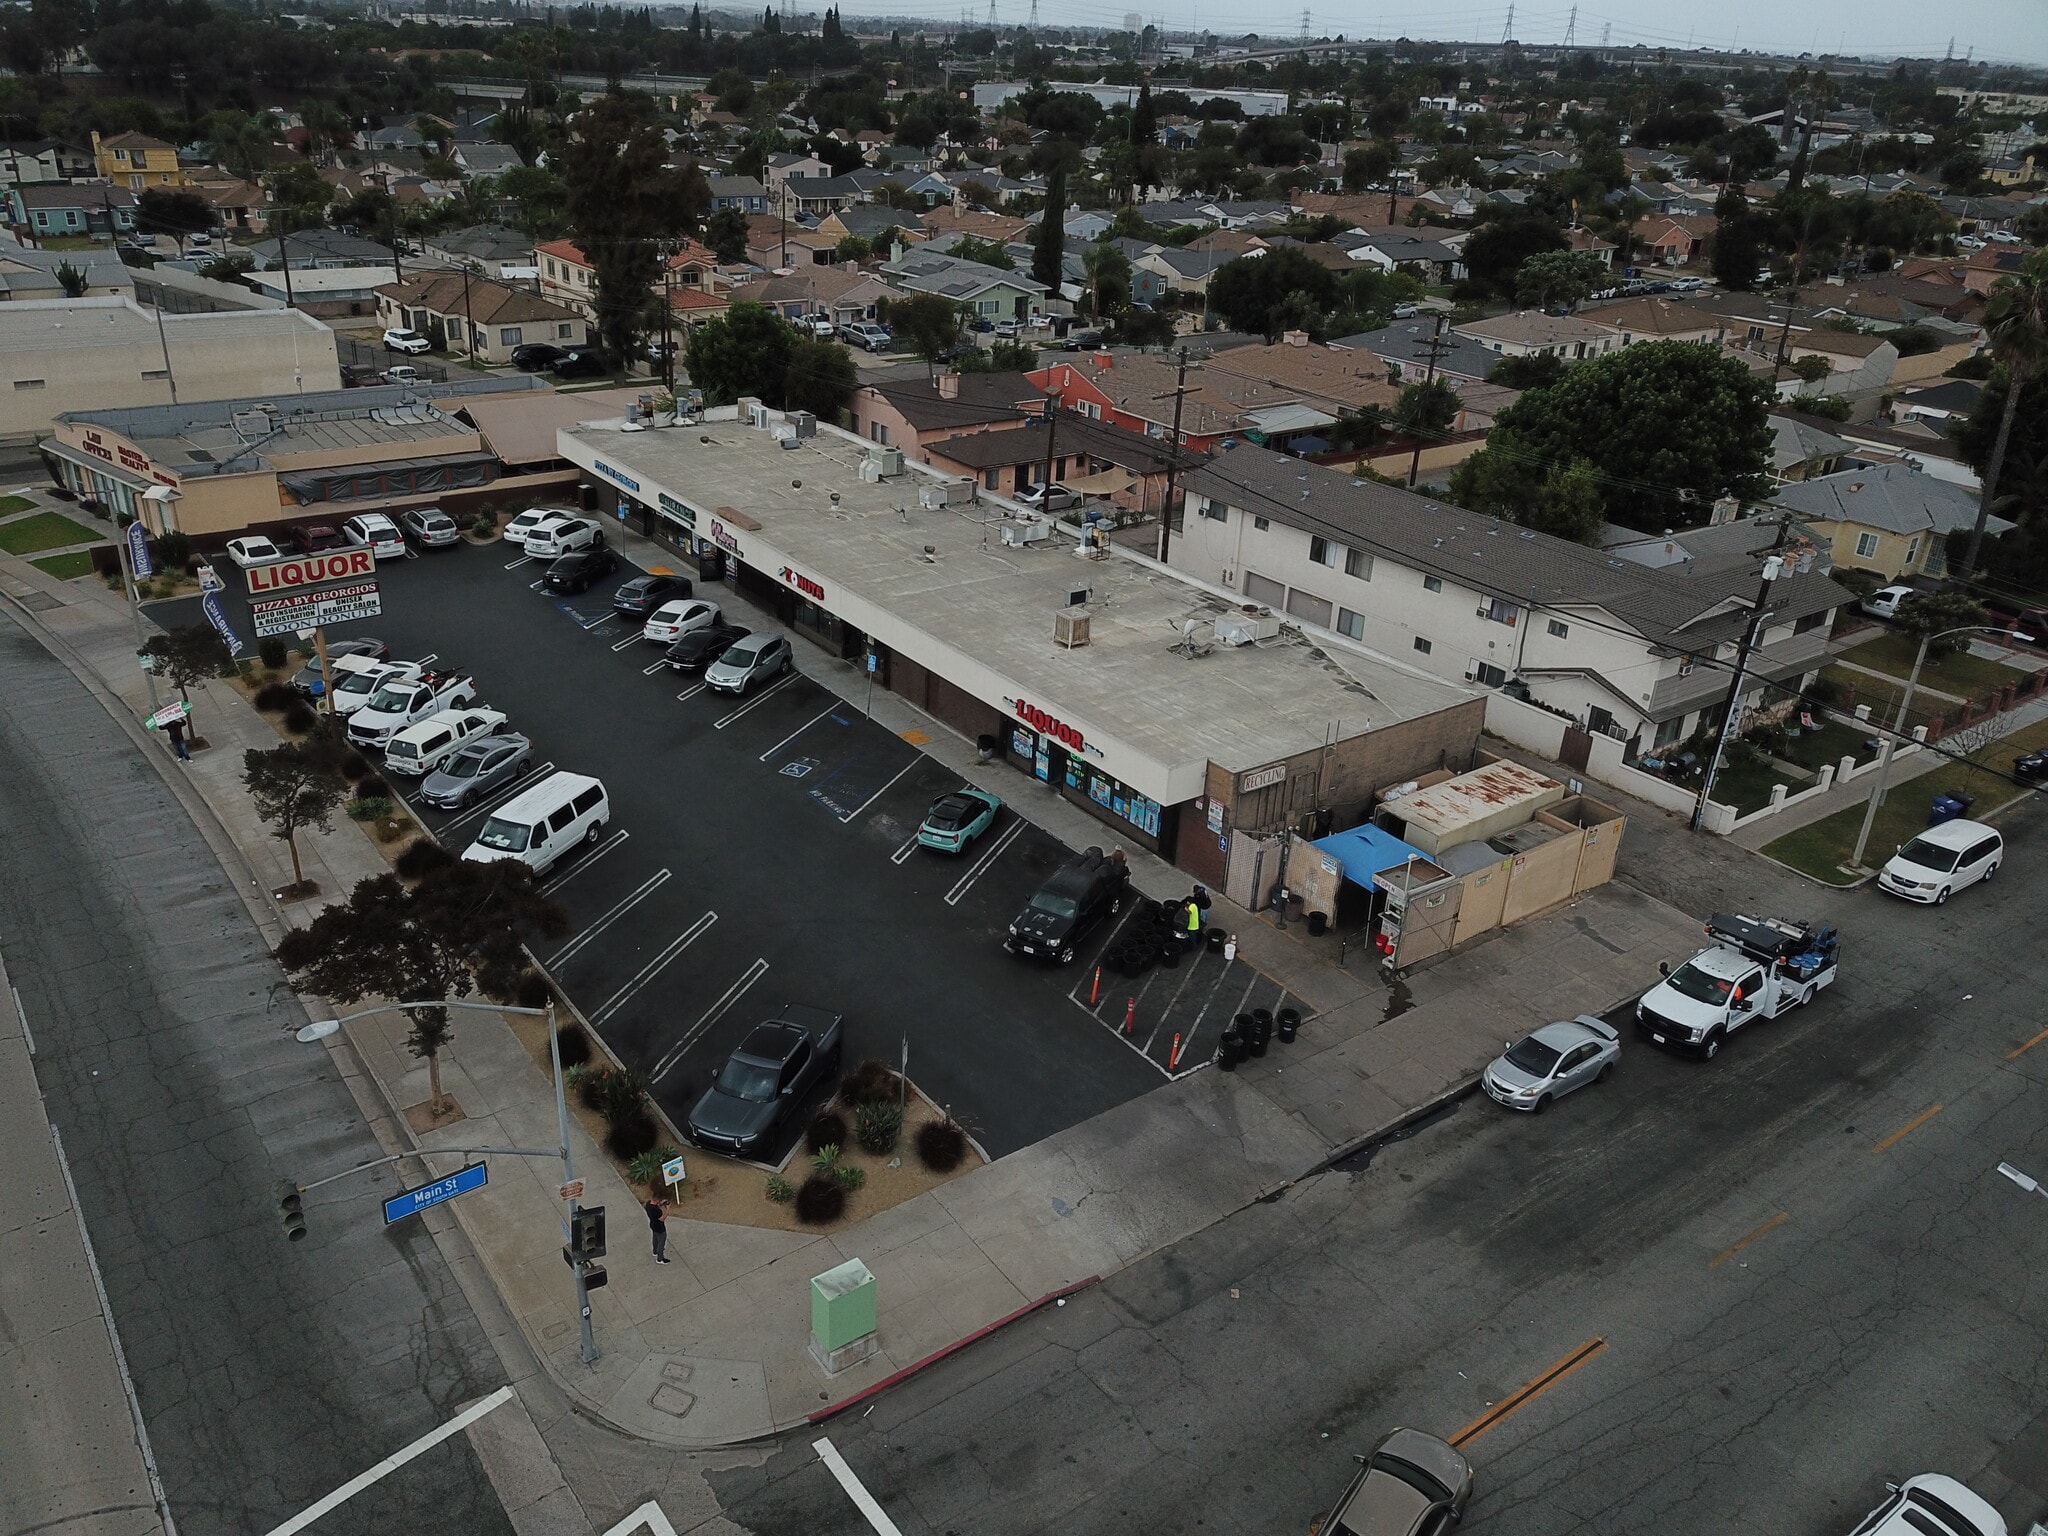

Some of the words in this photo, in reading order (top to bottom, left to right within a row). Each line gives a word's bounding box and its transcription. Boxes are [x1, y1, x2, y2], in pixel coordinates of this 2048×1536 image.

[82, 440, 113, 461] OFFICES
[250, 552, 371, 590] LIQUOR
[783, 566, 825, 601] DONUTS
[253, 599, 292, 613] PIZZA
[293, 595, 311, 606] BY
[312, 583, 377, 602] GEORGIOS
[322, 604, 352, 614] BEAUTY
[353, 600, 377, 609] SALON
[335, 596, 363, 606] UNISEX
[255, 612, 275, 621] AUTO
[276, 604, 316, 617] INSURANCE
[262, 620, 311, 635] MOON
[317, 608, 377, 624] DONUTS
[265, 610, 316, 624] REGISTRATION
[1016, 698, 1085, 752] LIQUOR
[1244, 767, 1285, 790] RECYCLING
[1381, 880, 1396, 893] OPEN
[414, 1187, 442, 1203] Main
[445, 1178, 458, 1191] St
